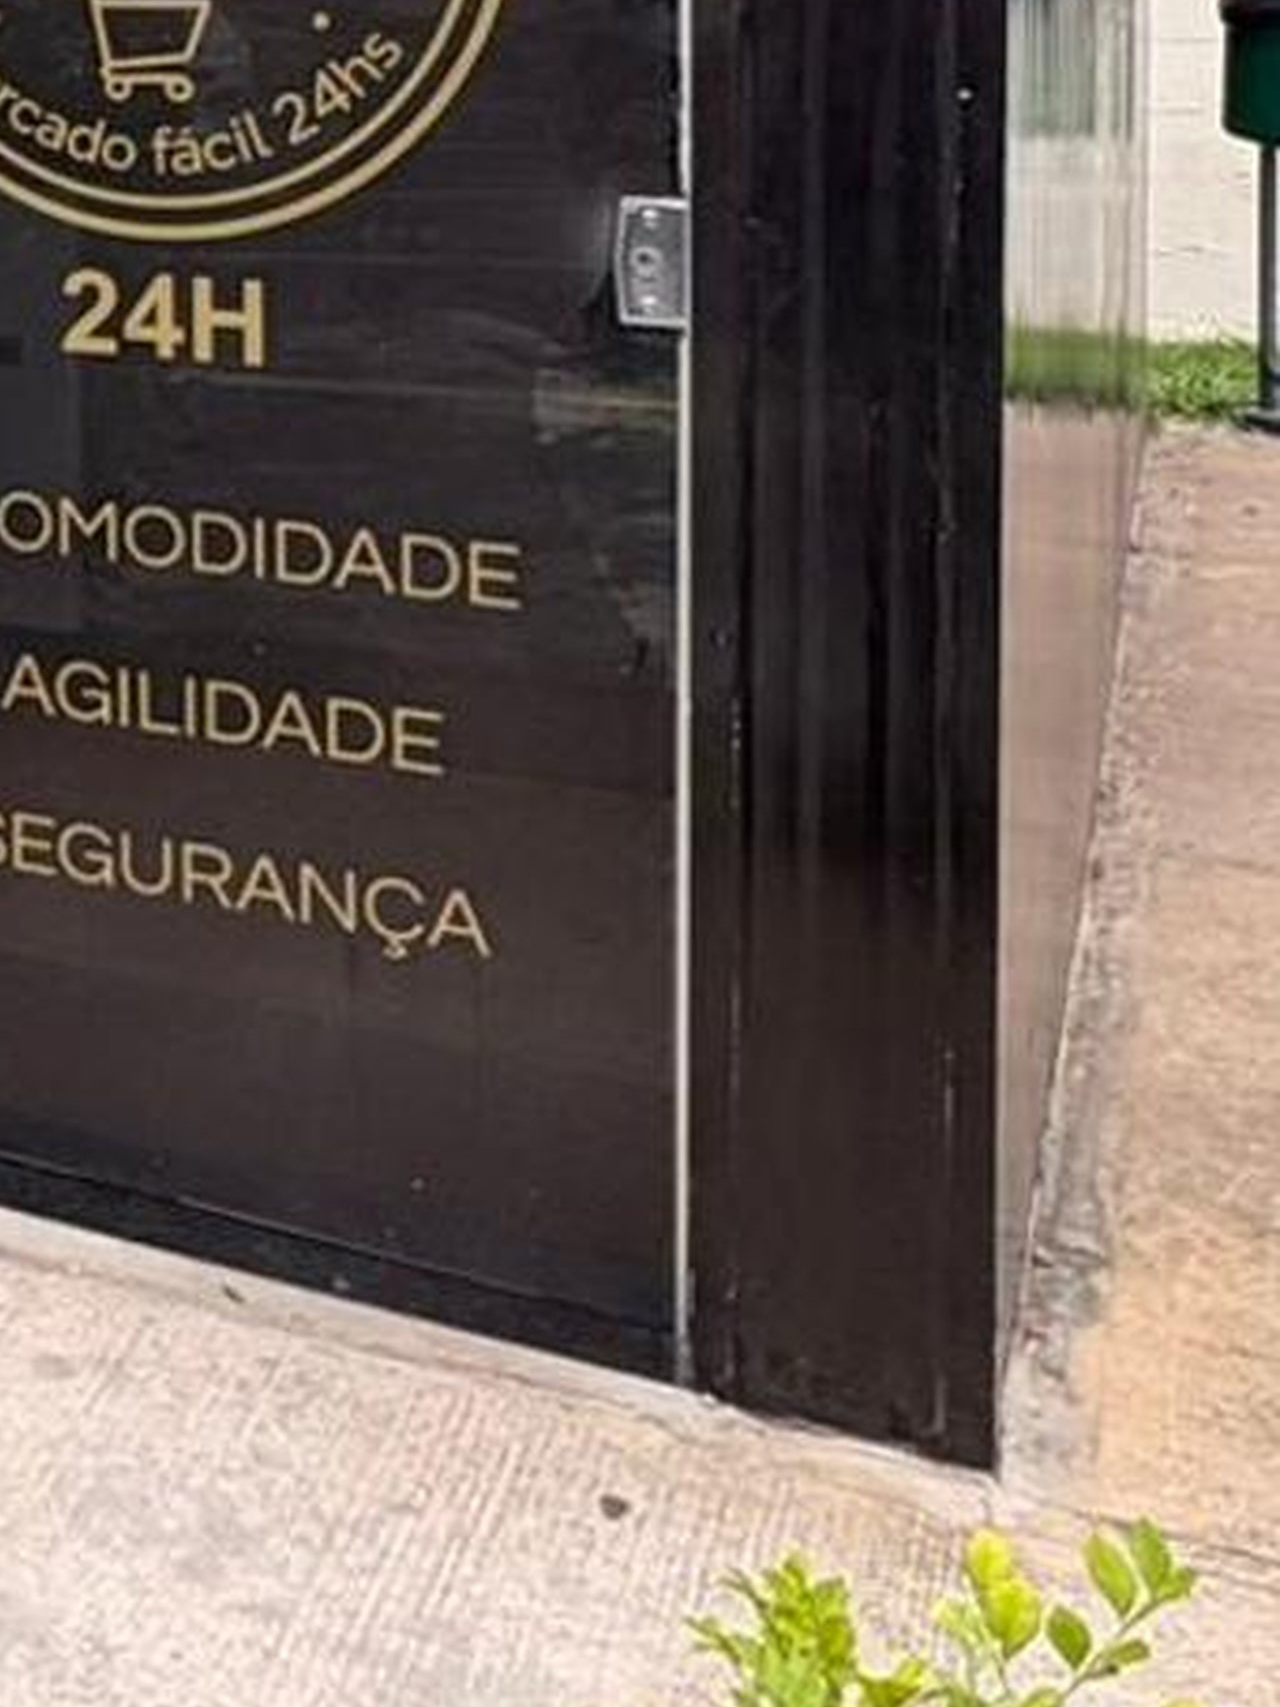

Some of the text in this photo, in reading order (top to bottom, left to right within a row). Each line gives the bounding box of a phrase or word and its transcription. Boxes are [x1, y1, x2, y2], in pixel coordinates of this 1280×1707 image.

[153, 112, 273, 178] fácil
[272, 31, 404, 146] 24hs
[60, 268, 266, 368] 24H
[0, 652, 444, 776] AGILIDADE
